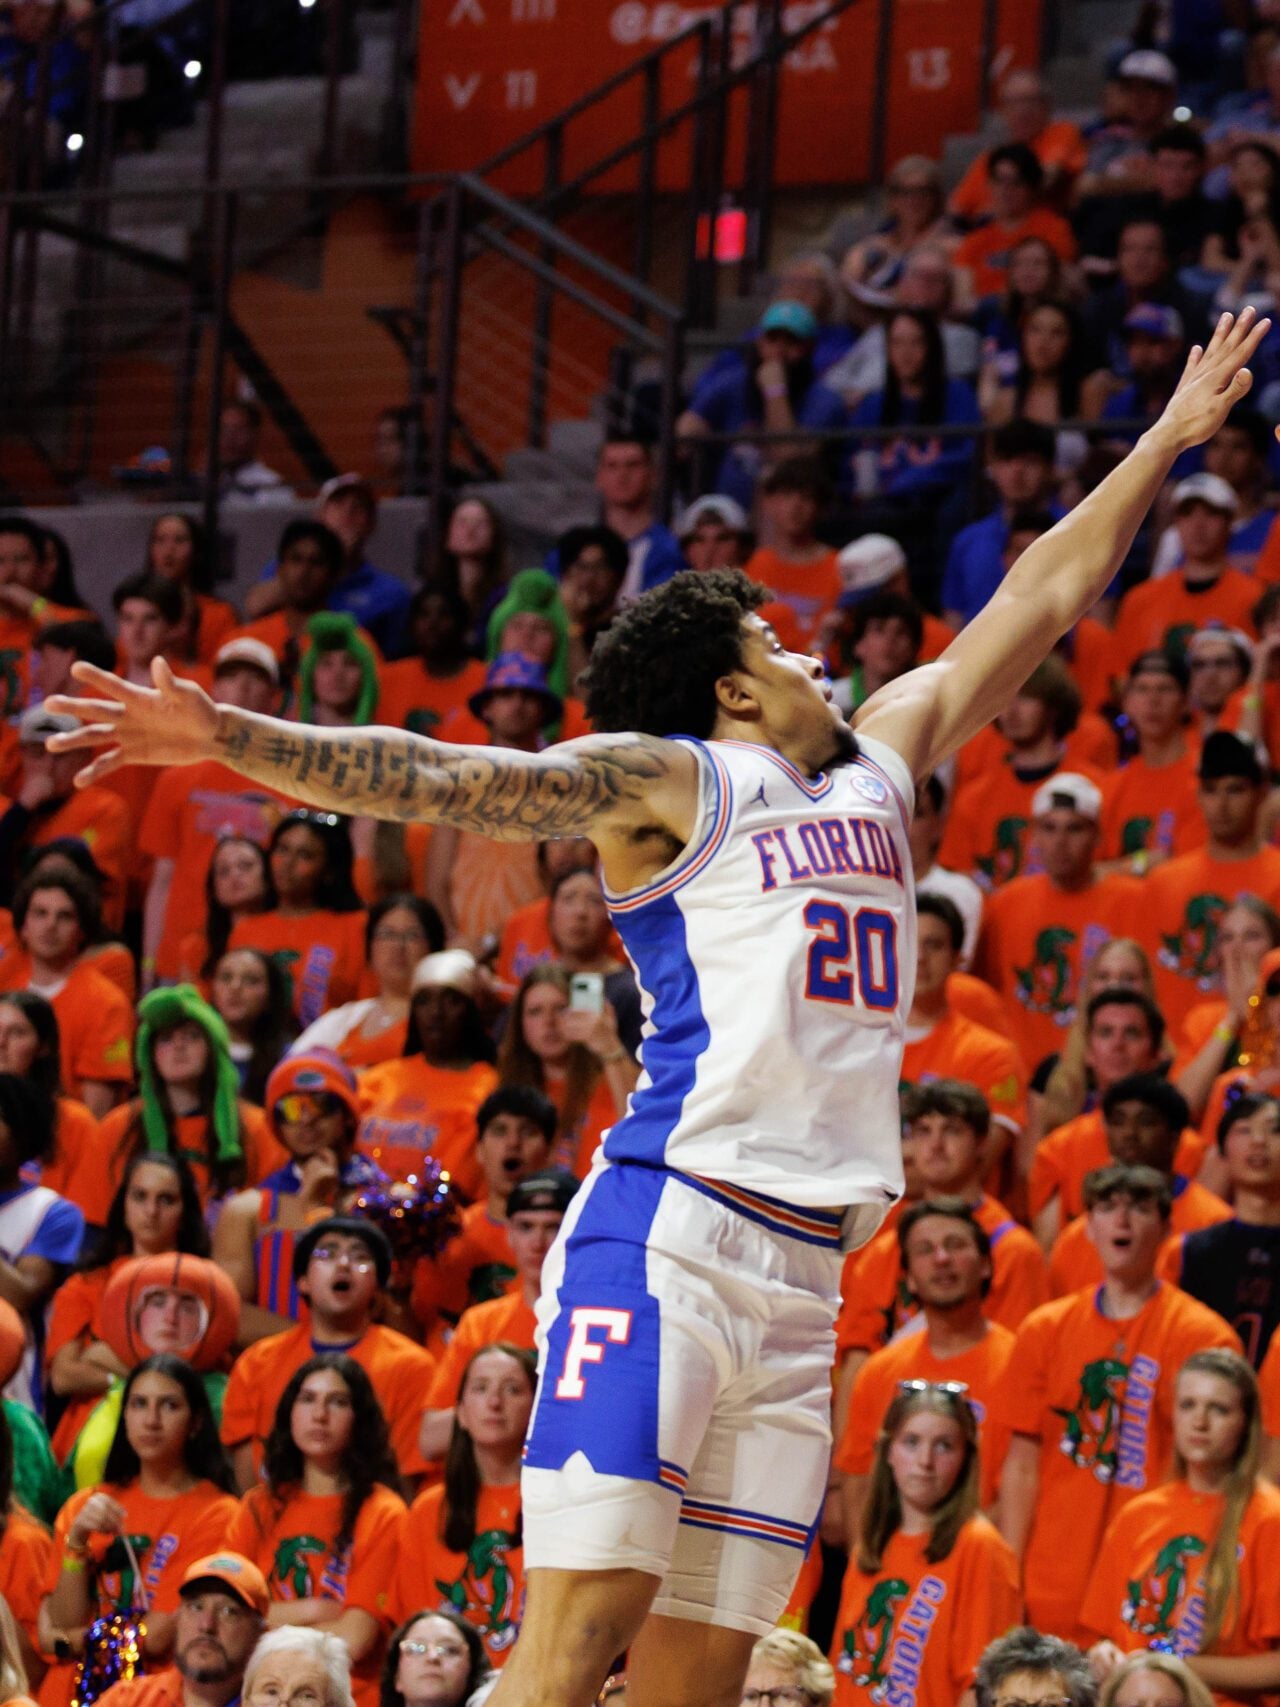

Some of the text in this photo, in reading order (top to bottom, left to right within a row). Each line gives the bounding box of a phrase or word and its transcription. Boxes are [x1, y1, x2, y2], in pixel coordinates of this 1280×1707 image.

[750, 817, 905, 892] FLORIDA
[803, 897, 899, 1013] 20
[555, 1306, 633, 1400] F
[1115, 1353, 1161, 1490] GATORS
